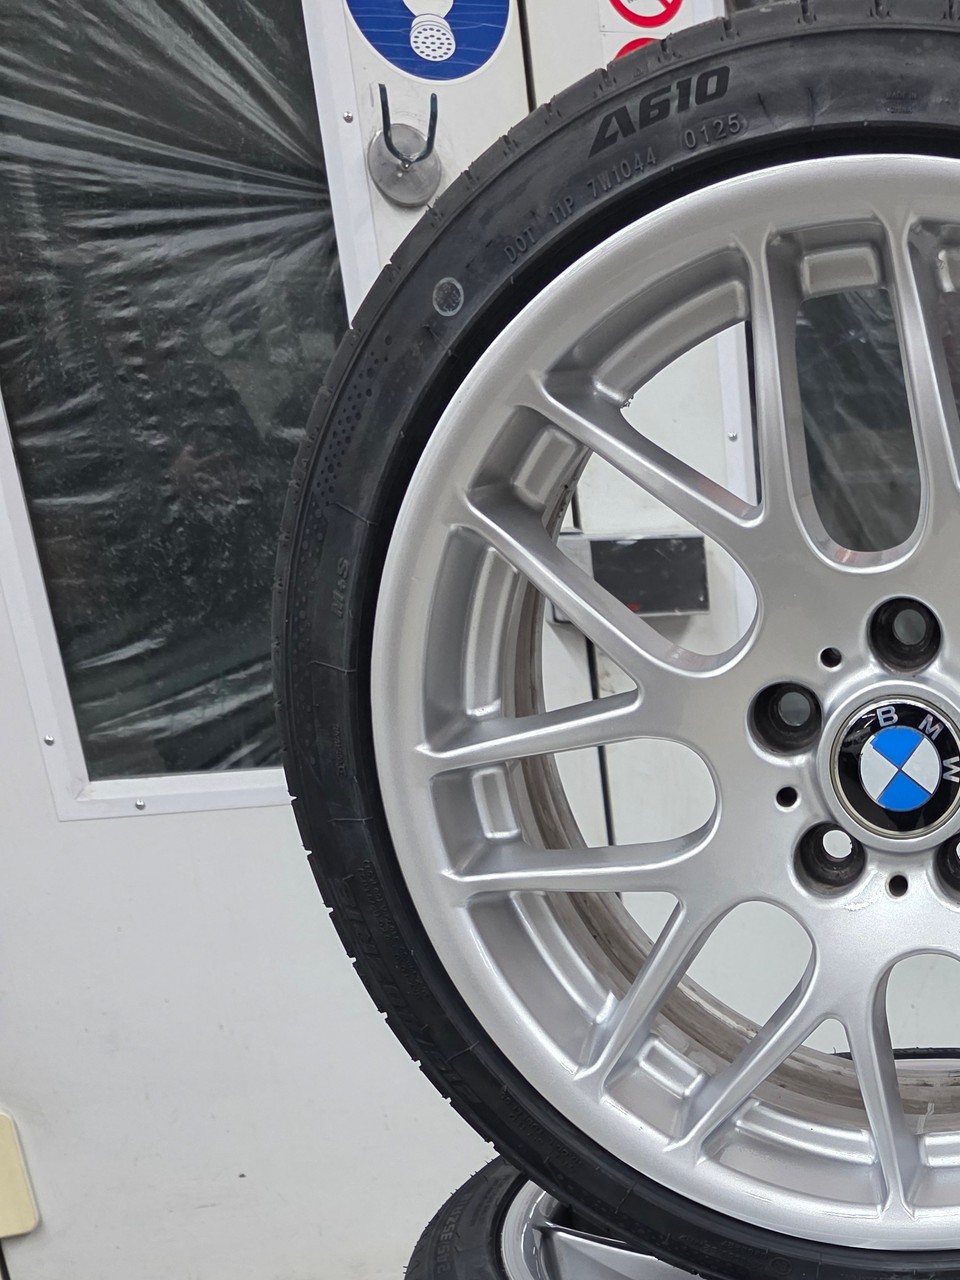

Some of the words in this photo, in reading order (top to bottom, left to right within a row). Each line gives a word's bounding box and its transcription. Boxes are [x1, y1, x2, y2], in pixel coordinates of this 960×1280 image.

[588, 64, 732, 158] A610
[505, 226, 538, 264] DOT
[586, 146, 658, 199] 7W1044
[684, 114, 742, 152] 0125
[876, 705, 960, 782] BMW
